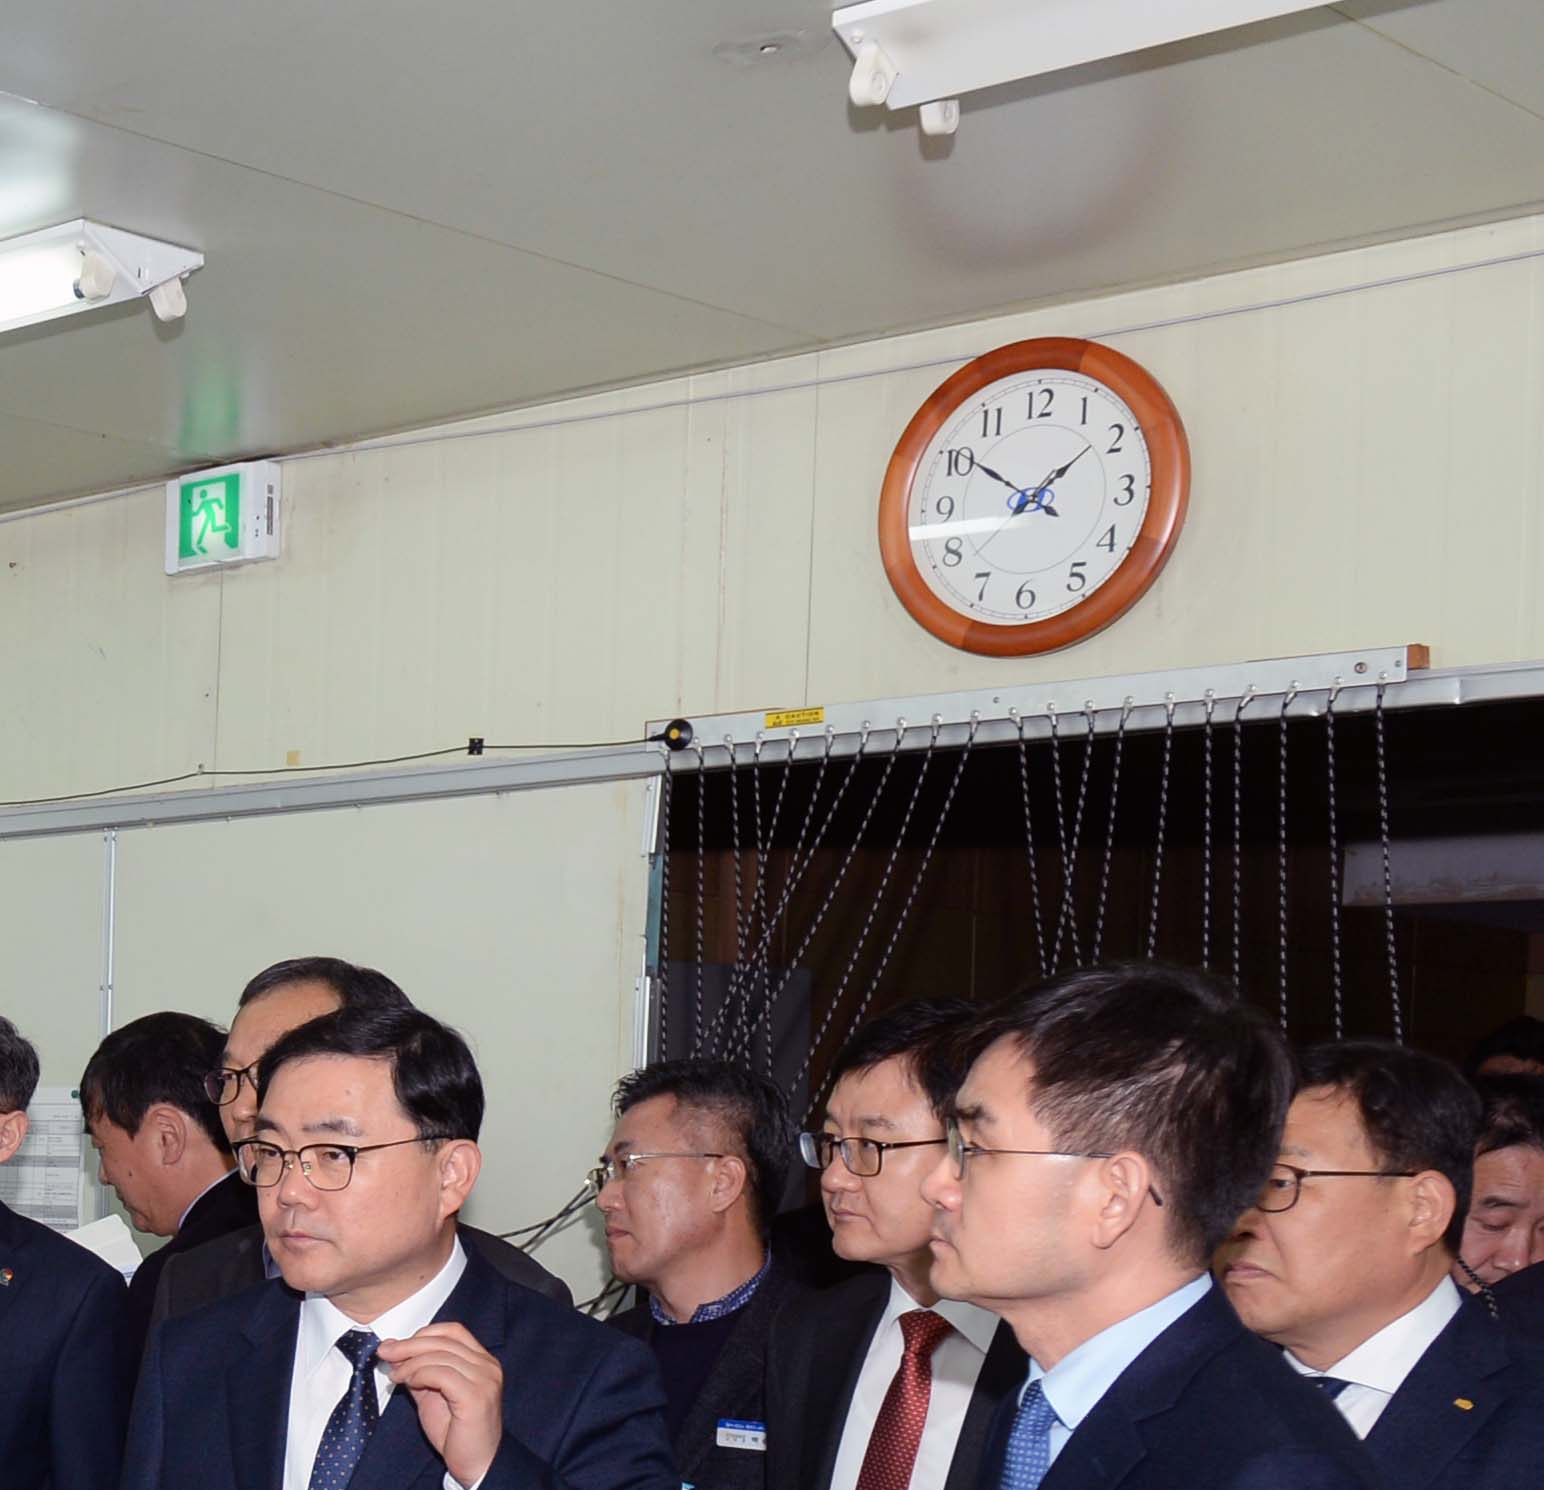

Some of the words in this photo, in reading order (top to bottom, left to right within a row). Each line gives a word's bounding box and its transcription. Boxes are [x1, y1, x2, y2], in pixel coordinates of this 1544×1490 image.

[1027, 388, 1055, 420] 12
[1080, 396, 1089, 425] 1
[981, 407, 1003, 438] 11
[1106, 424, 1125, 454] 2
[946, 446, 975, 477] 10
[1113, 474, 1135, 506] 3
[936, 496, 955, 522] 9
[942, 537, 963, 567] 8
[1096, 524, 1117, 553] 4
[975, 572, 992, 602] 7
[1066, 562, 1088, 593] 5
[1015, 579, 1036, 609] 6
